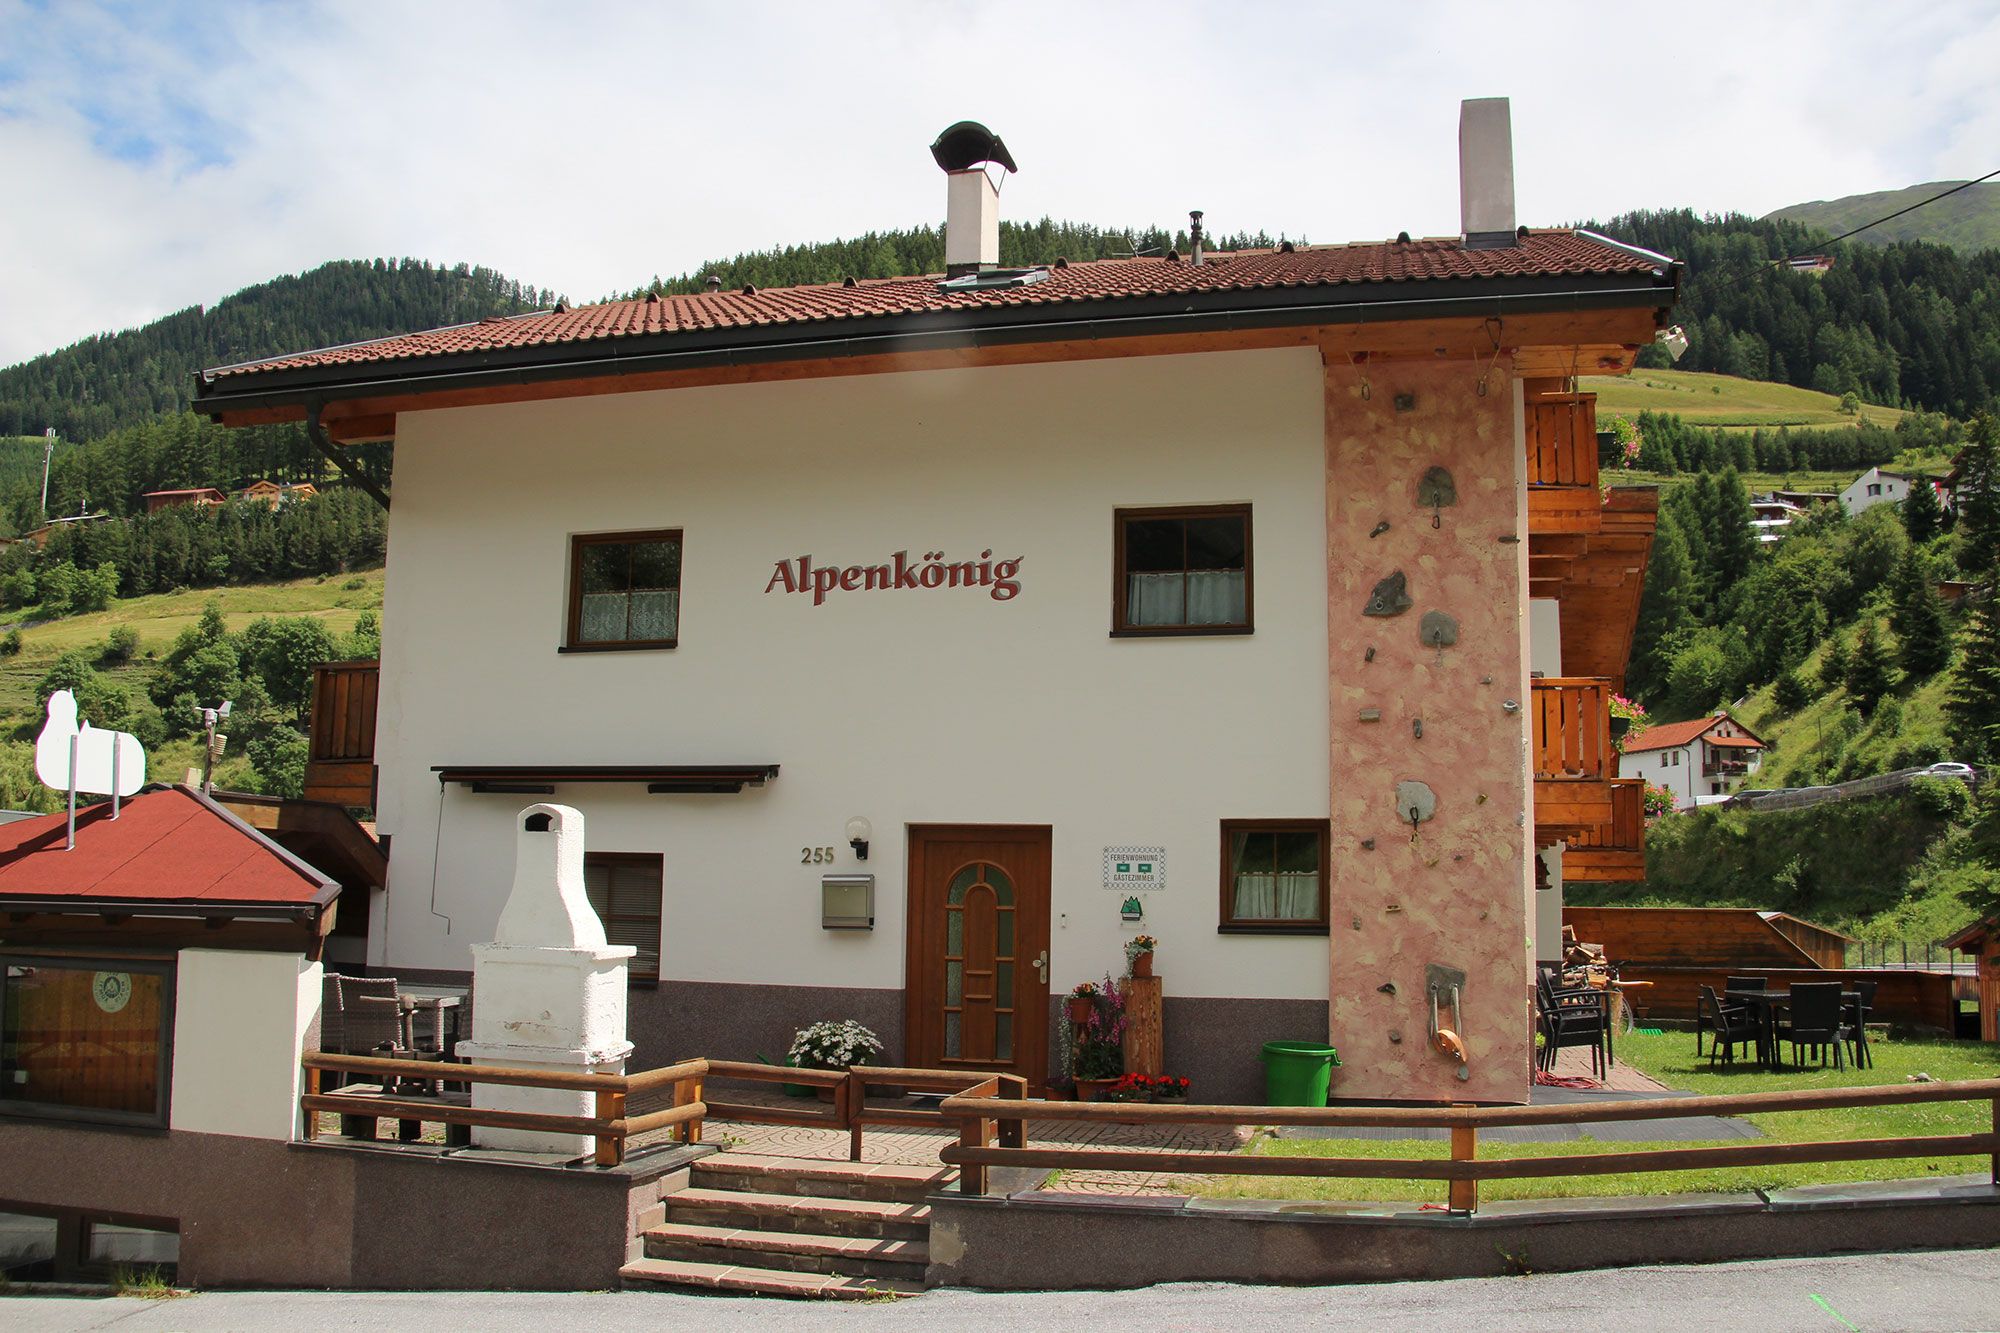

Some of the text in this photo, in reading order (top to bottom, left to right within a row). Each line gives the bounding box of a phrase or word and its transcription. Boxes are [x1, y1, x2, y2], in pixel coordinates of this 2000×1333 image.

[764, 549, 1024, 606] Alpenkönig
[801, 846, 834, 864] 255
[1110, 853, 1158, 862] FERIENWOHNUNG
